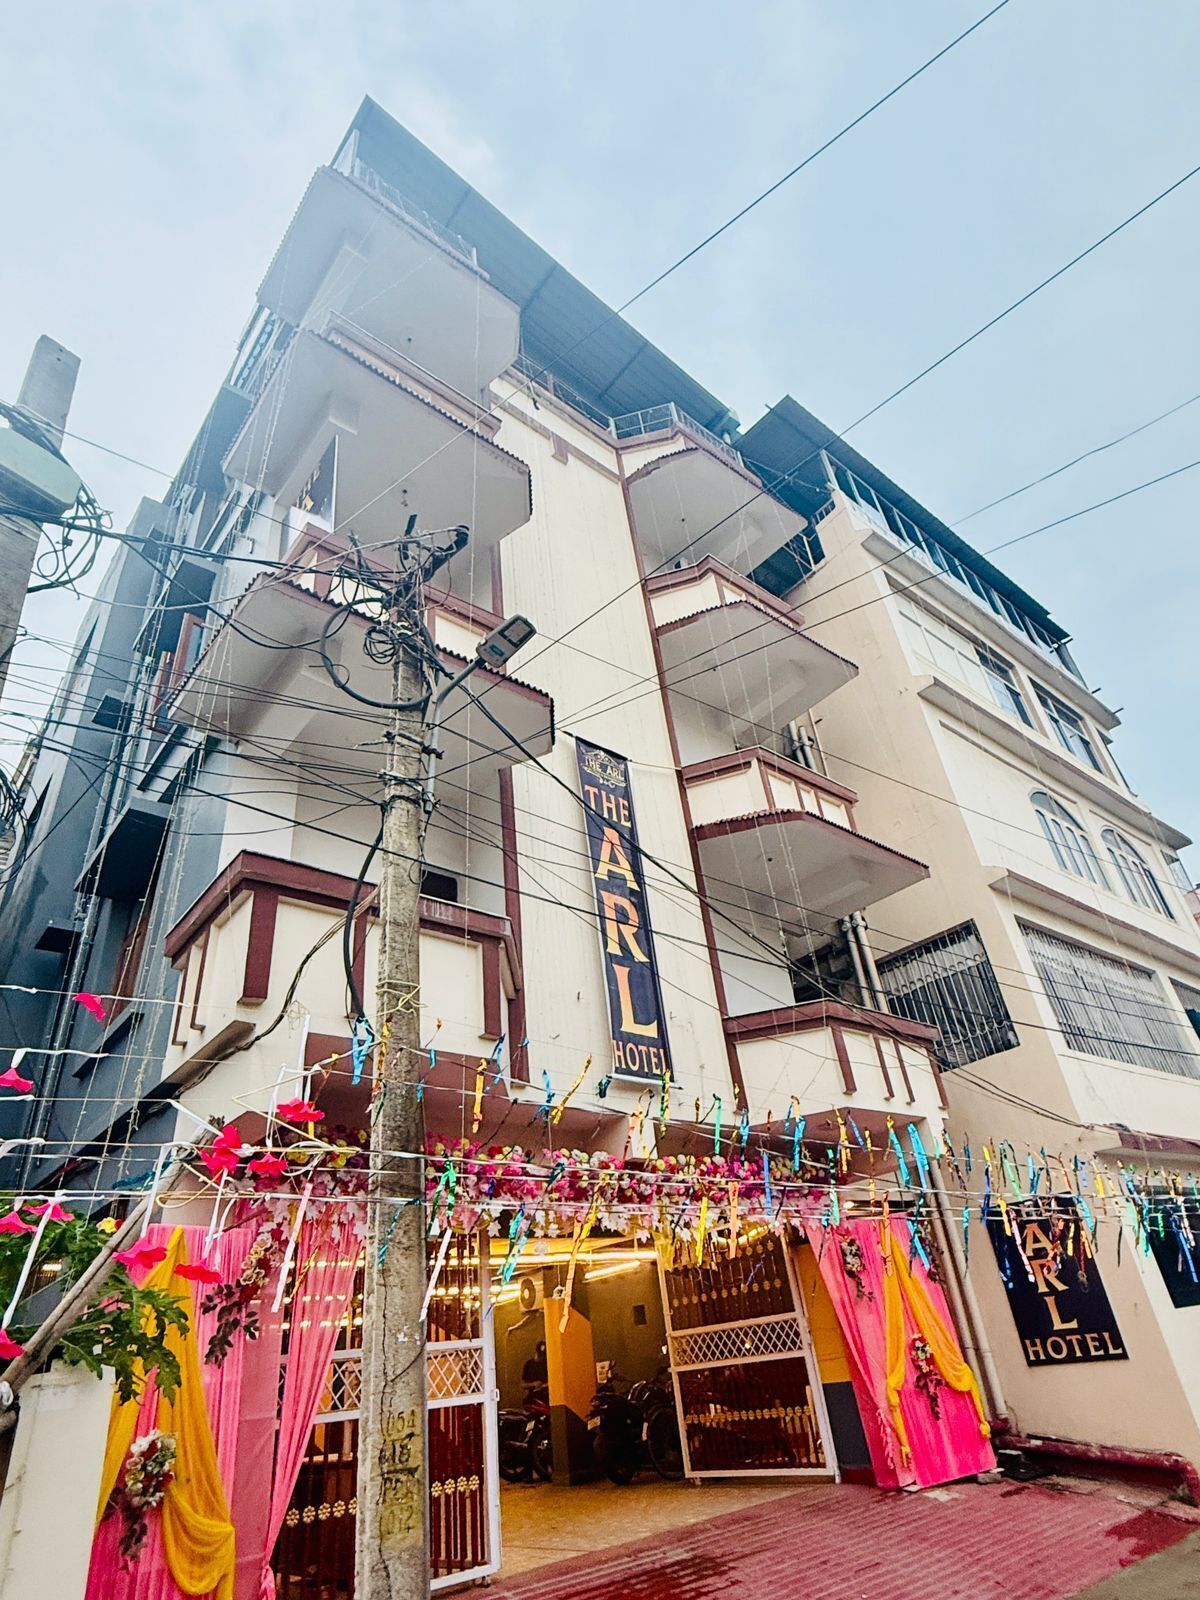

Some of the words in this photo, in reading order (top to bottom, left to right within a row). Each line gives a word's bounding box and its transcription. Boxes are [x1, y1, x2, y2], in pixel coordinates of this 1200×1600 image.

[584, 757, 601, 770] THE
[584, 785, 632, 827] THE
[1023, 1332, 1123, 1361] HOTEL
